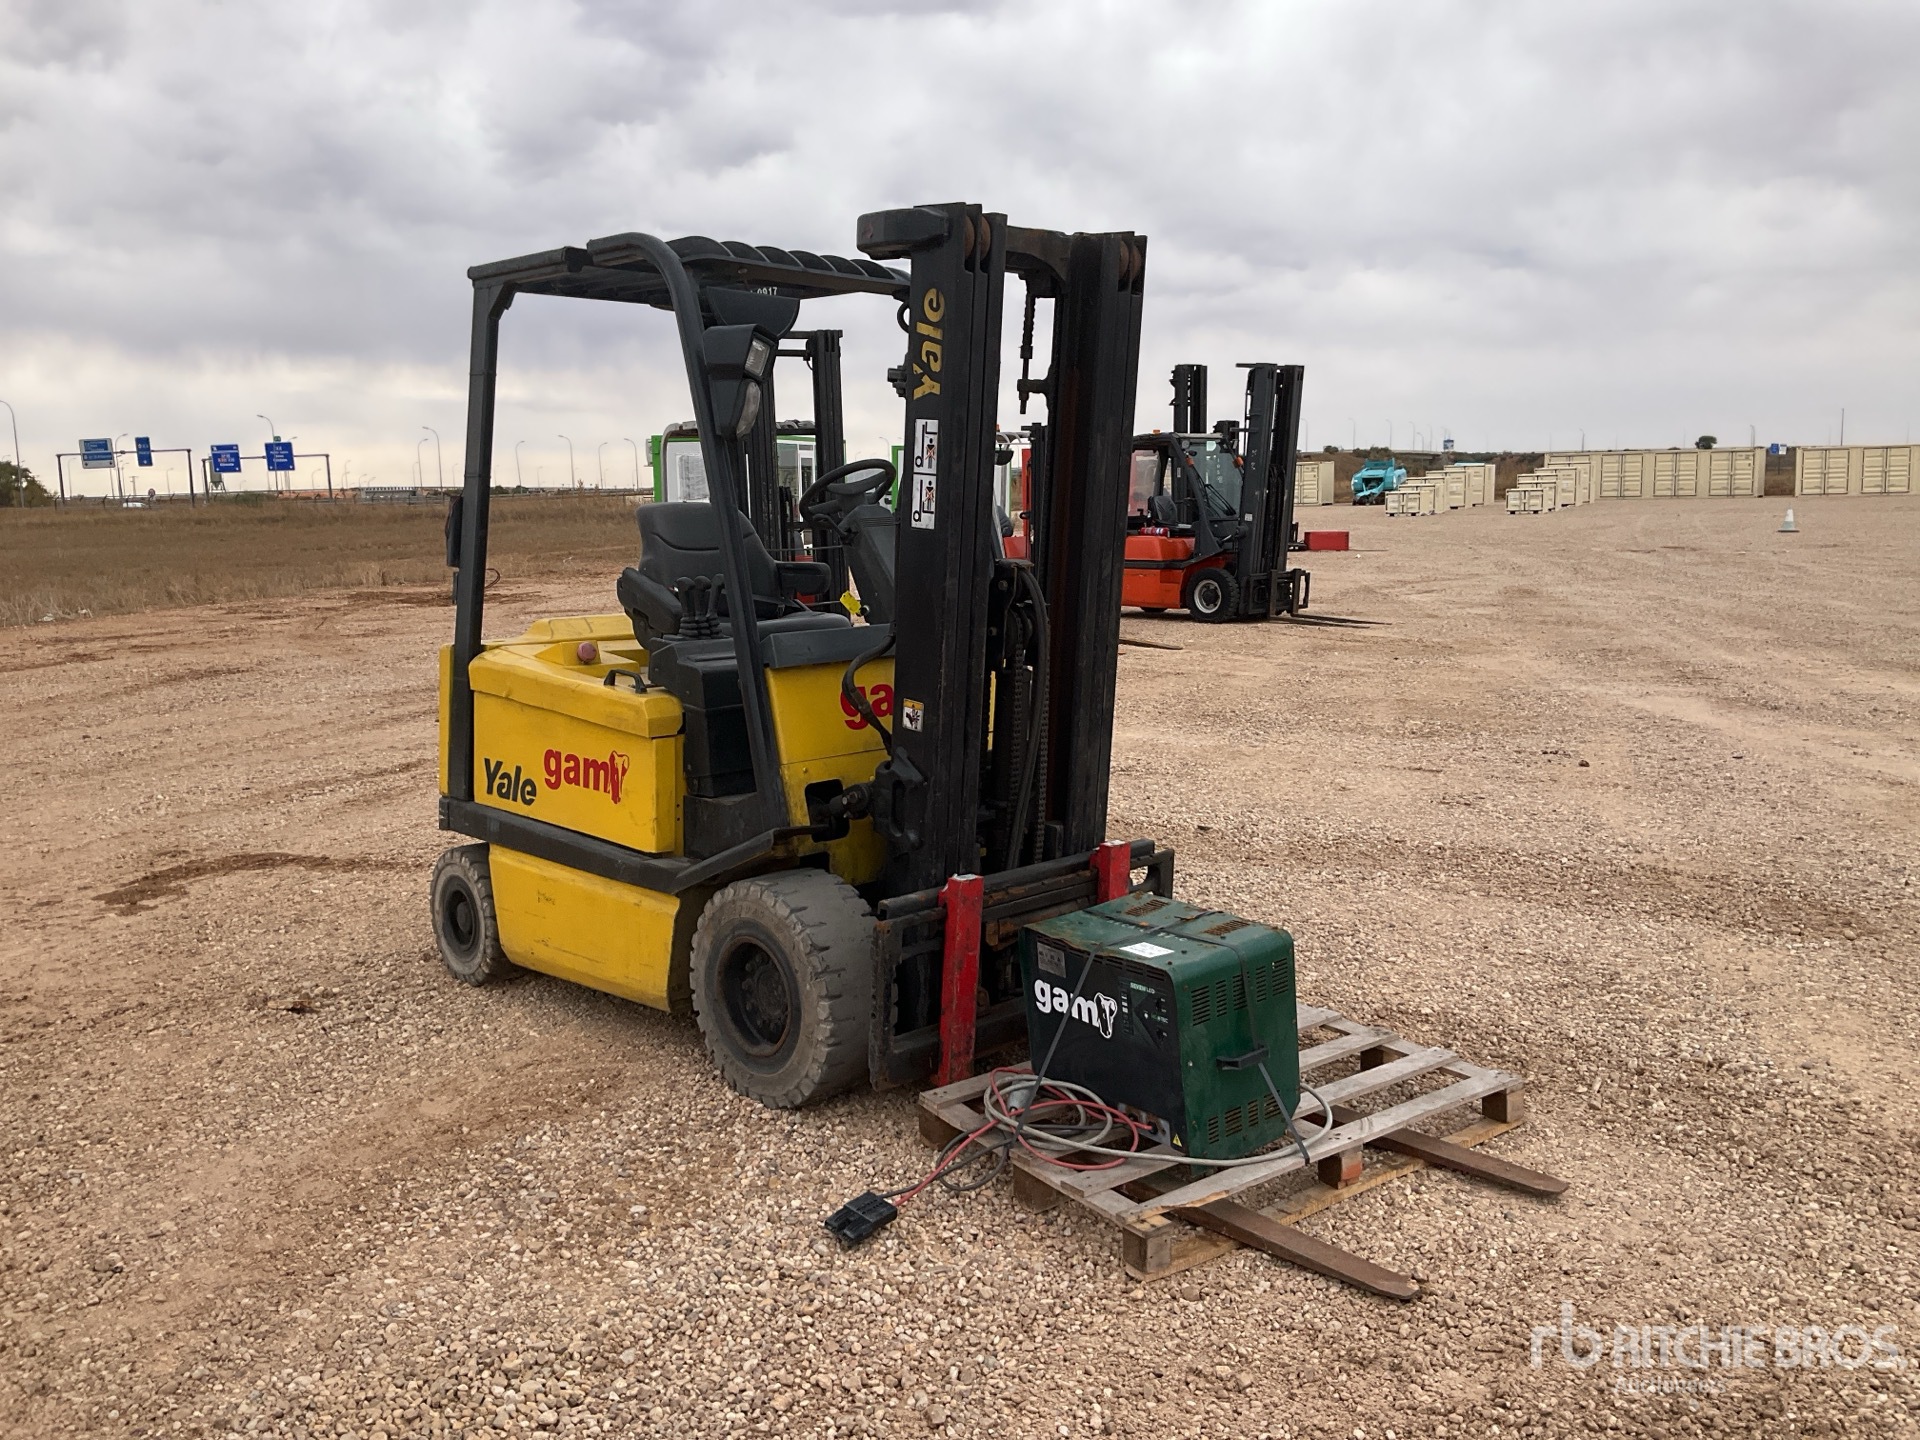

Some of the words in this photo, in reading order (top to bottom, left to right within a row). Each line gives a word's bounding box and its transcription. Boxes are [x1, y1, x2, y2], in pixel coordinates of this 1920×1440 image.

[912, 287, 946, 400] Yale
[840, 684, 894, 730] ga
[484, 757, 537, 806] Yale
[544, 748, 611, 794] gam
[1034, 979, 1100, 1028] gam
